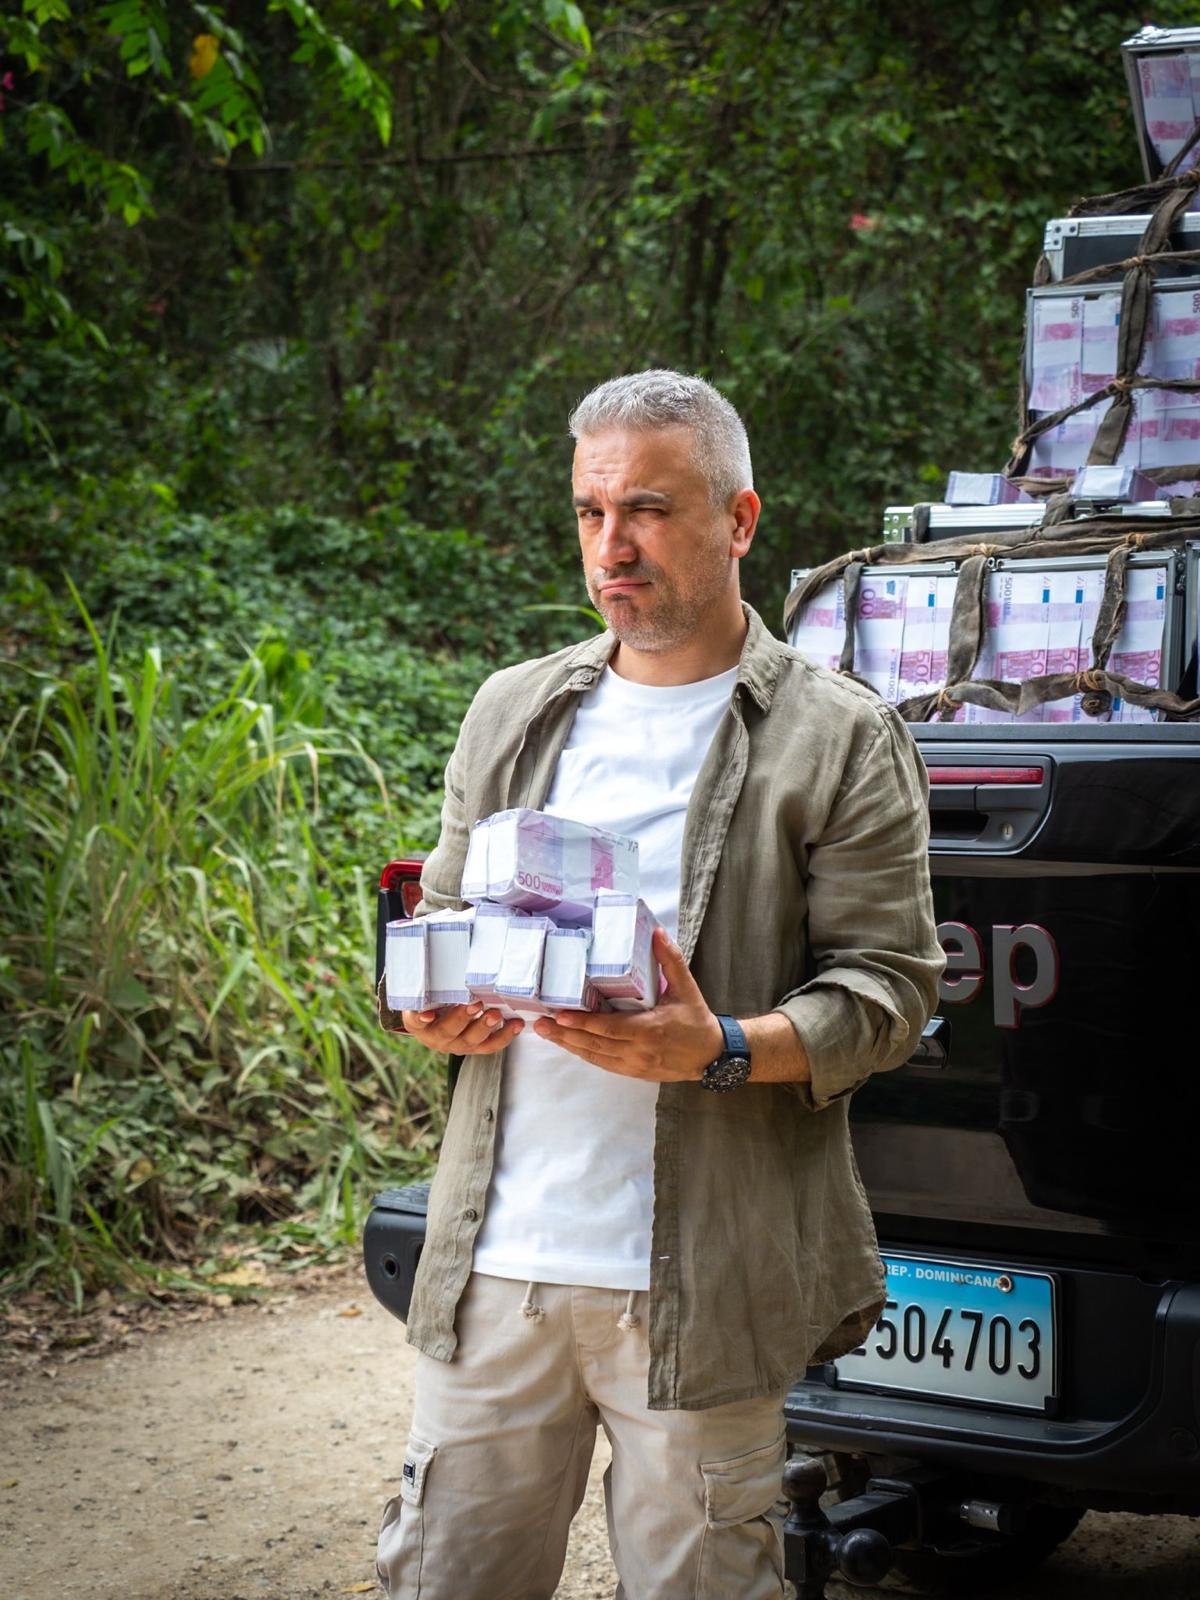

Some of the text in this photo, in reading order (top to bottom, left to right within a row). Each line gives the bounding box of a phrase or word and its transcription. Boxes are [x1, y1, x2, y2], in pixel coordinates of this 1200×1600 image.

[1030, 649, 1045, 675] 50
[518, 871, 541, 889] 500
[936, 921, 1060, 1028] ep
[916, 1268, 999, 1289] DOMINICANA
[850, 1299, 1041, 1379] 504703
